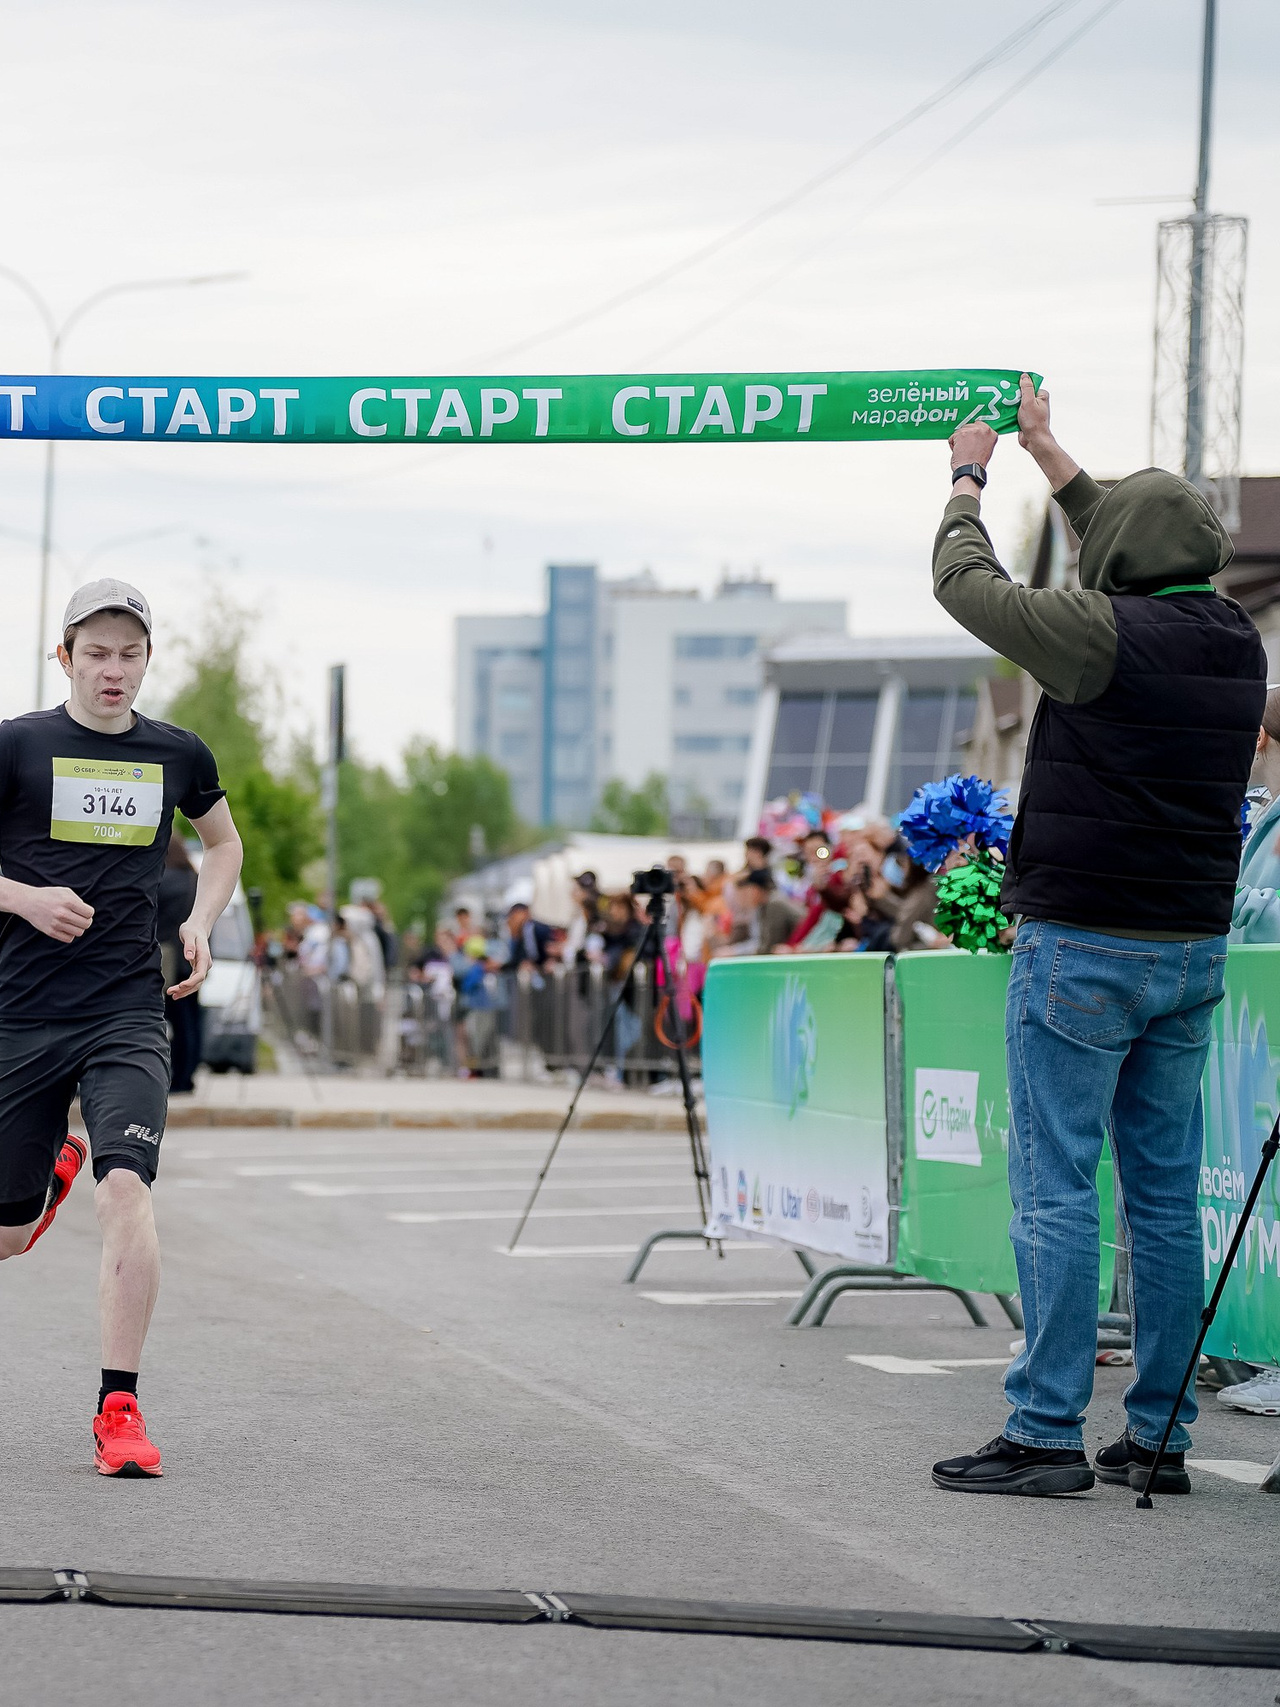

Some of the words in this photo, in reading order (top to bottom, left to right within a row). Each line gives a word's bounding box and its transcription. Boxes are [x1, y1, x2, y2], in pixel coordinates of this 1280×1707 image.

[867, 380, 969, 403] зелёный
[85, 386, 300, 436] СТАРТ
[349, 387, 563, 437] СТАРТ
[612, 383, 828, 436] СТАРТ
[851, 403, 959, 428] марафон
[82, 794, 137, 817] 3146
[940, 1096, 972, 1141] Прайм
[124, 1123, 160, 1146] FILA
[1197, 1155, 1246, 1202] воём
